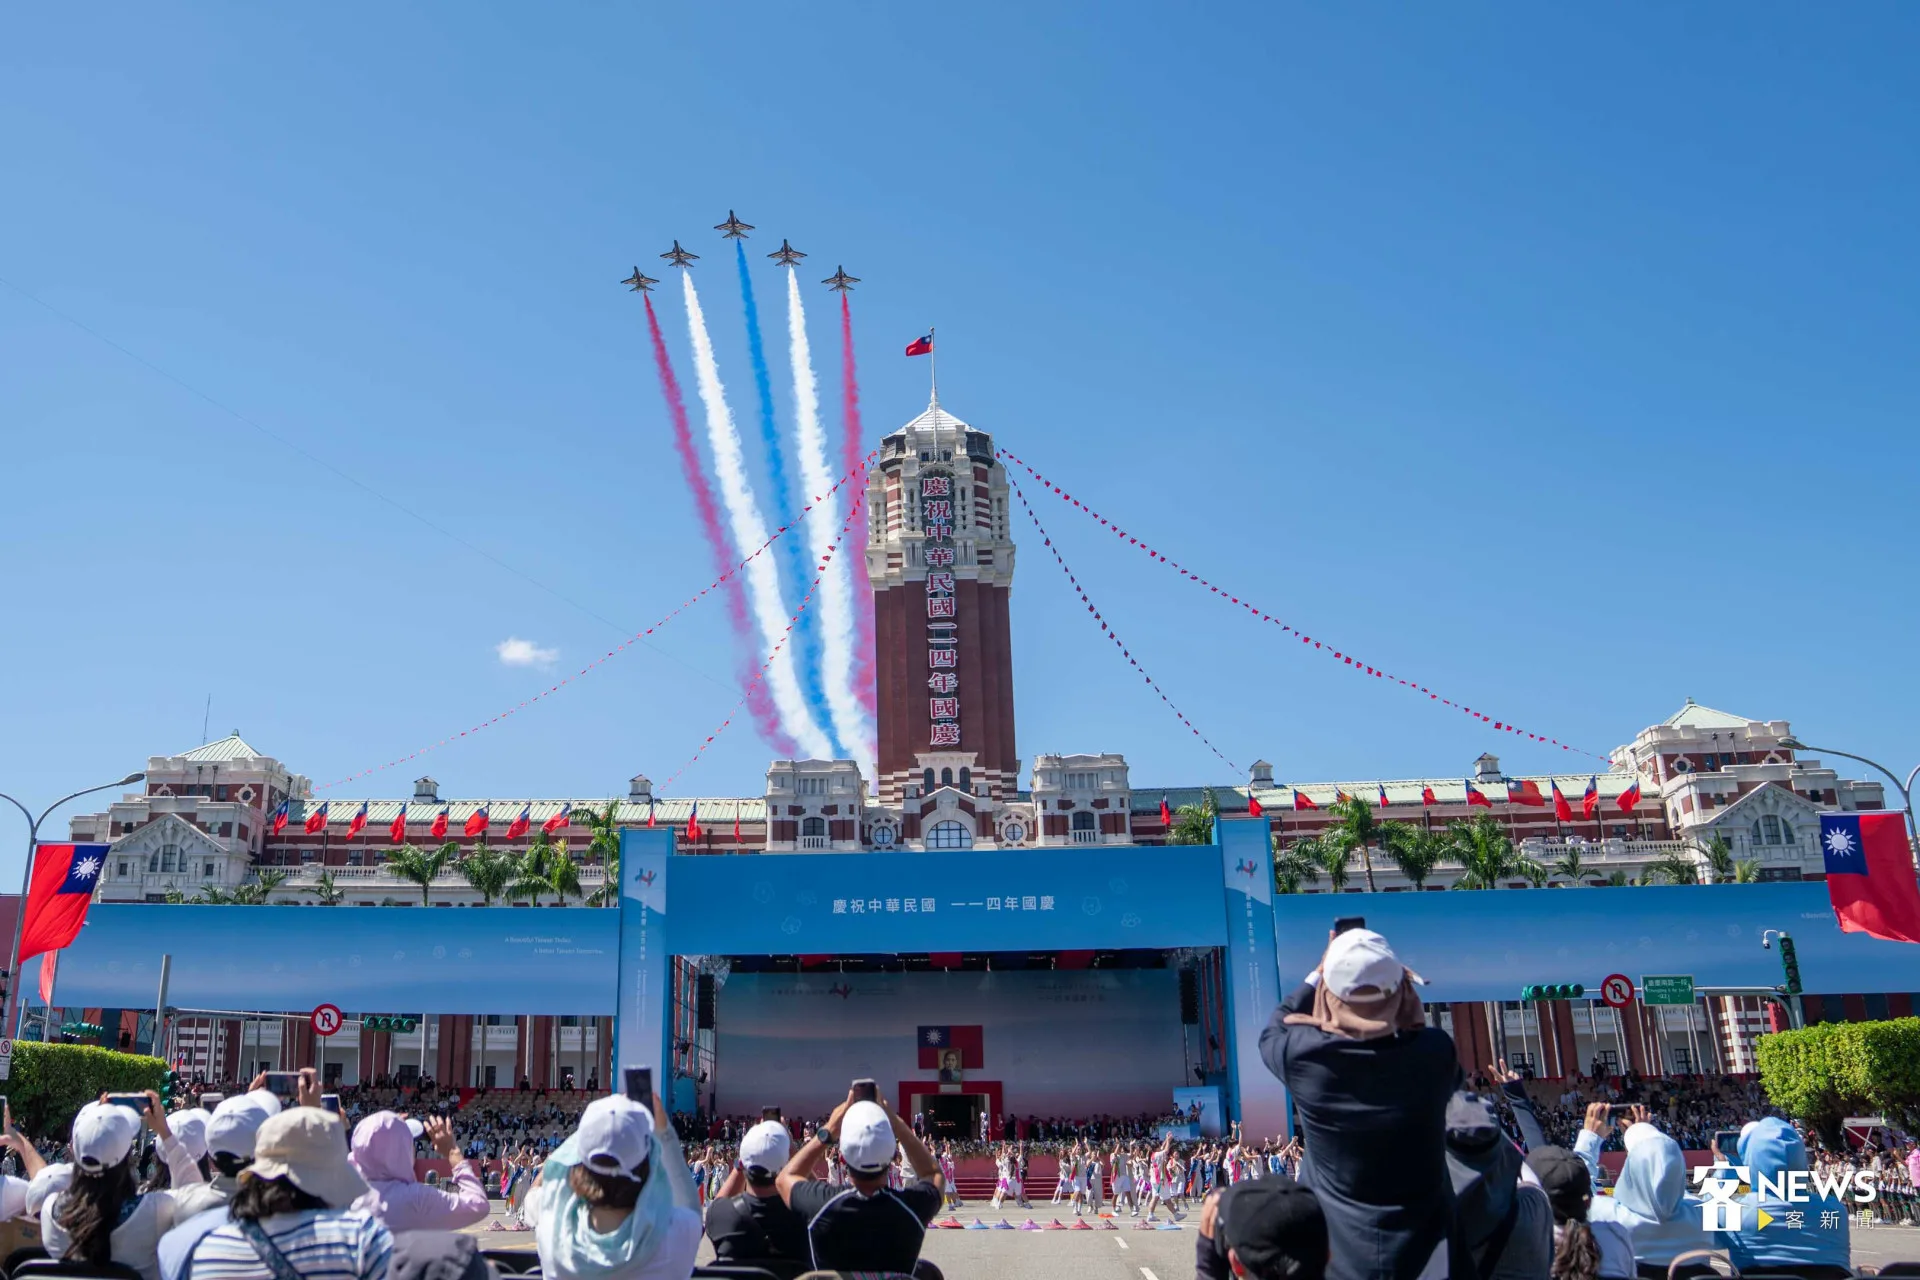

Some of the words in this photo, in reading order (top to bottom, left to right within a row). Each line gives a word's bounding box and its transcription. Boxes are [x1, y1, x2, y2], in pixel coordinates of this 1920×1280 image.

[922, 476, 960, 746] 慶祝中華民國一一四年國慶
[832, 898, 936, 914] 慶祝中華民國
[951, 895, 1055, 911] 一一四年國慶
